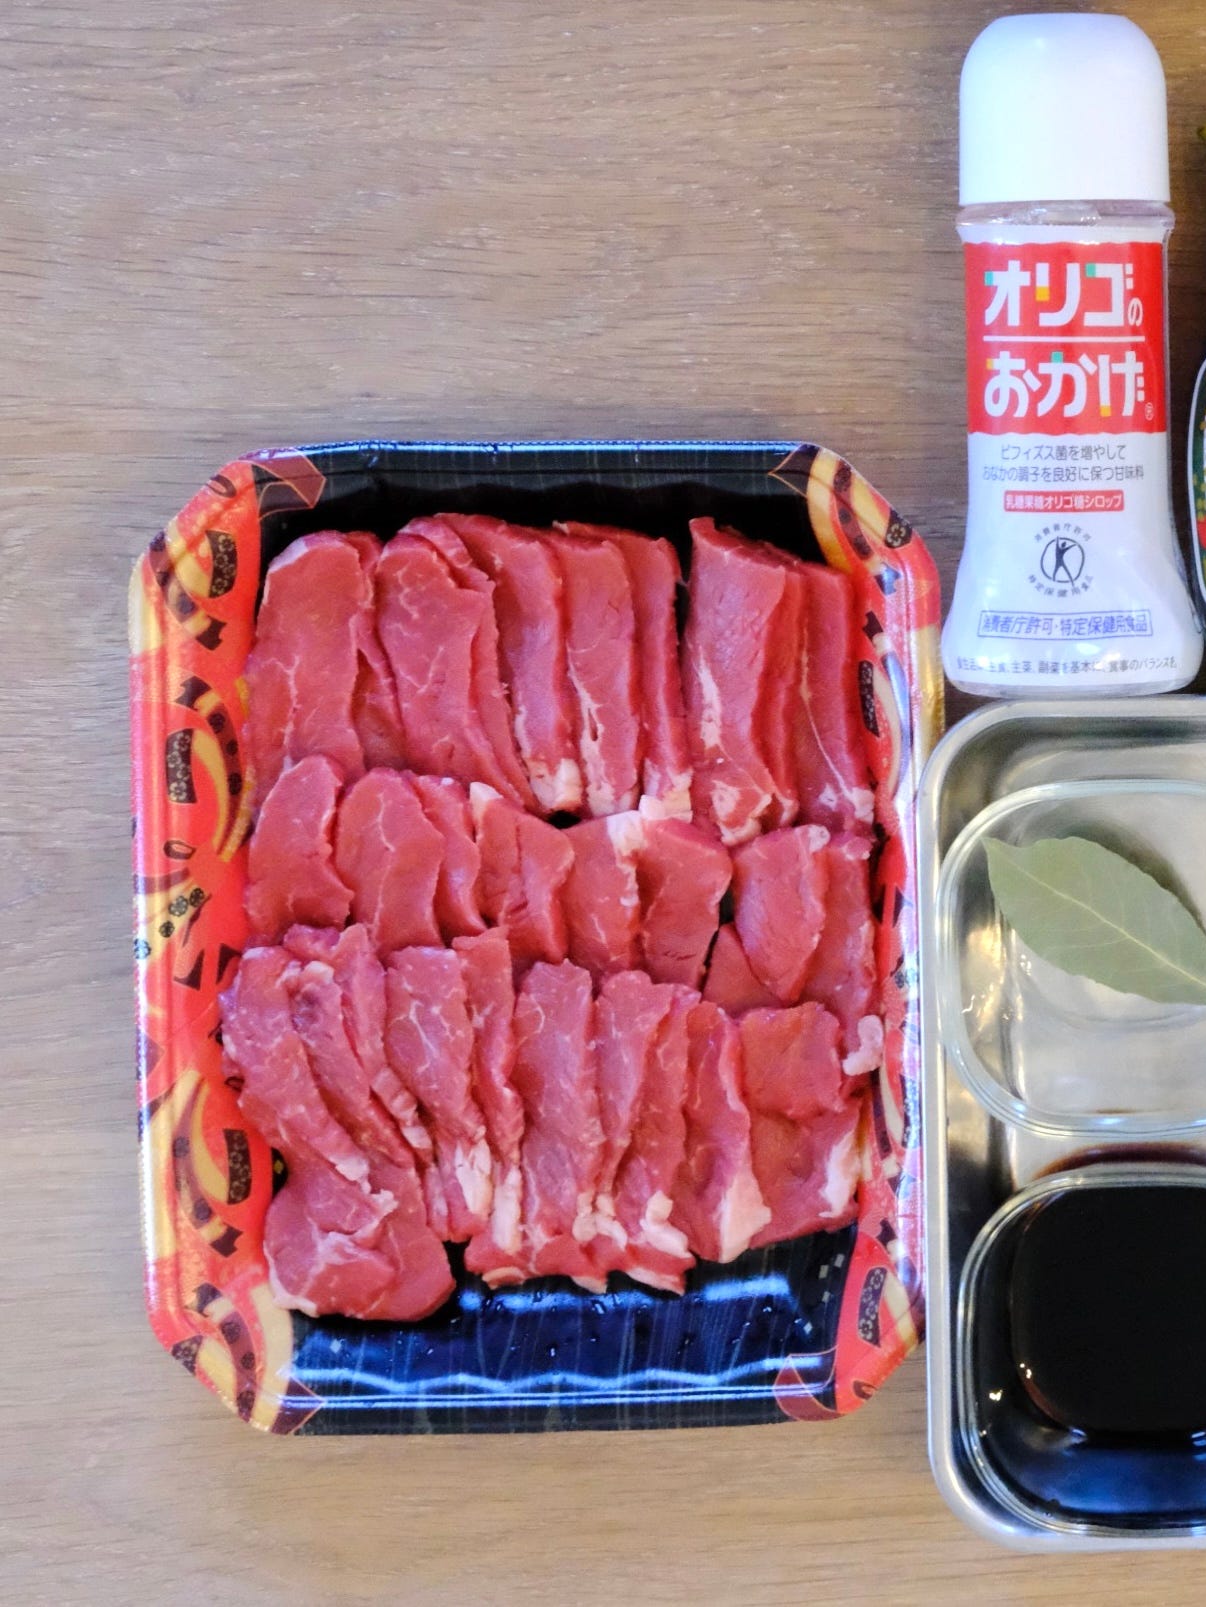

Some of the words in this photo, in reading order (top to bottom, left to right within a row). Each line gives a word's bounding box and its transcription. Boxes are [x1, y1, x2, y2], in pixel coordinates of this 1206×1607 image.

[984, 260, 1143, 327] オリゴの
[1001, 443, 1126, 462] ビフィズス菌を増やして
[982, 465, 1144, 483] おなかの調子を良好に保つ甘味料
